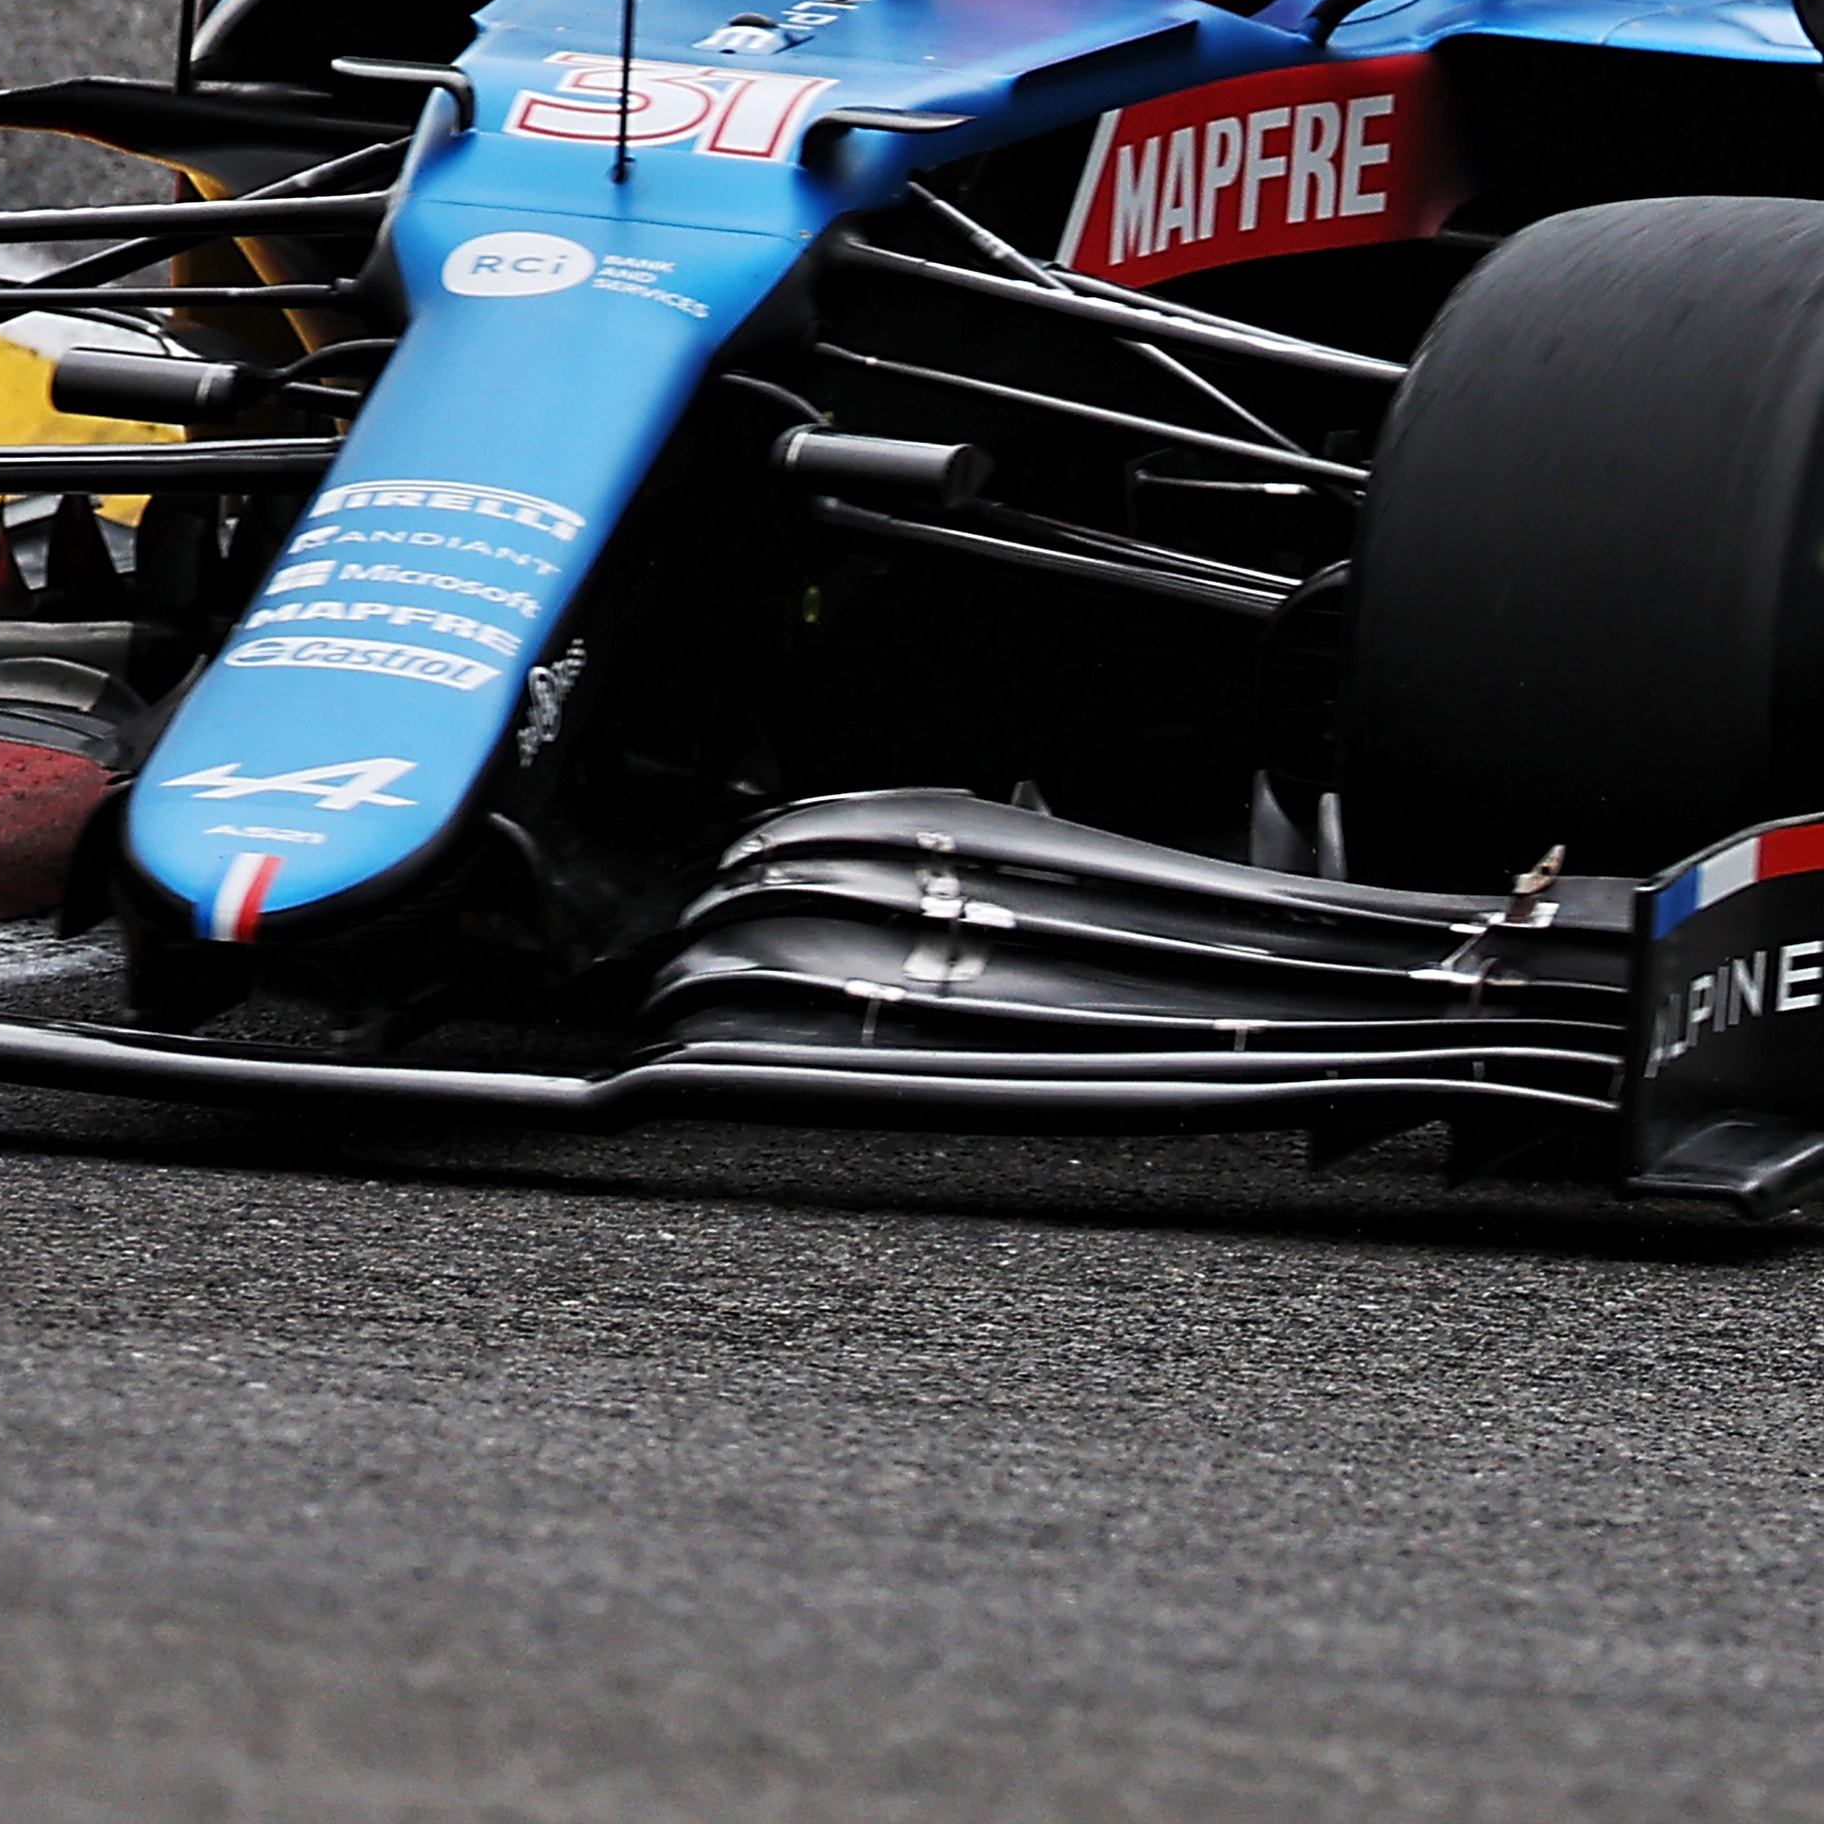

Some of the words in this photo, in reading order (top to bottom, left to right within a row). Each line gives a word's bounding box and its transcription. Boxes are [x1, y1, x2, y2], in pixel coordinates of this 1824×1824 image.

[503, 51, 841, 163] 31
[1107, 93, 1396, 267] MAPFRE
[591, 278, 711, 319] SERVICES
[596, 266, 658, 284] AND
[308, 480, 588, 543] PIRELLI
[338, 563, 542, 619] Microsoft
[244, 601, 523, 656] MAPFRE
[293, 640, 479, 682] Castrol
